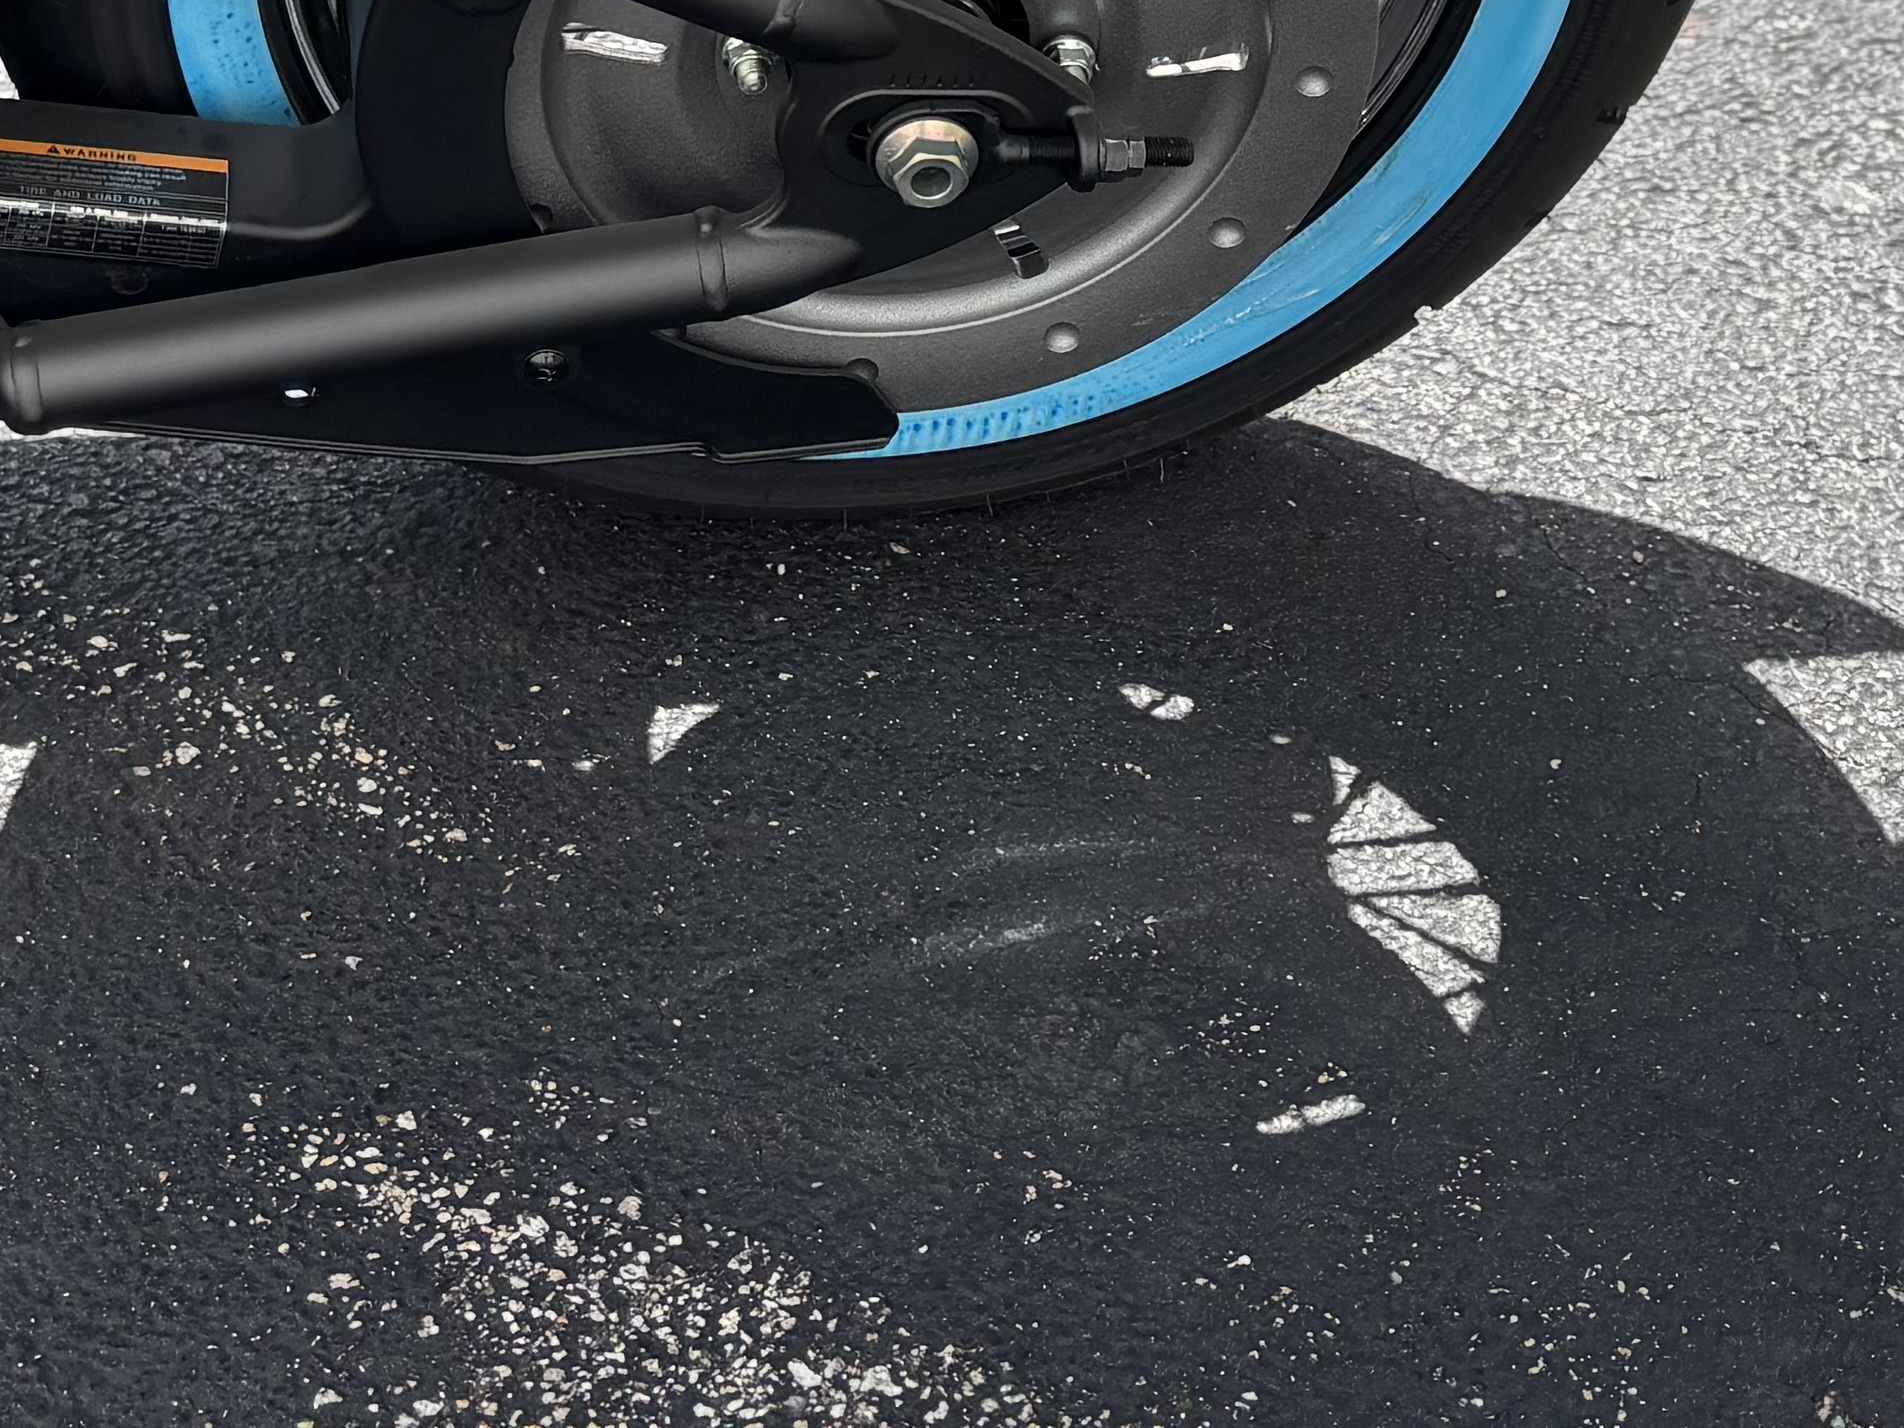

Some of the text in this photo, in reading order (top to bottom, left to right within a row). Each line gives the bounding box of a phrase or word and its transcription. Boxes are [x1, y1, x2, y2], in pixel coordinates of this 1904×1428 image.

[64, 148, 137, 161] WARNING
[53, 188, 81, 200] AND
[87, 192, 122, 204] LOAD
[128, 195, 162, 207] DATA
